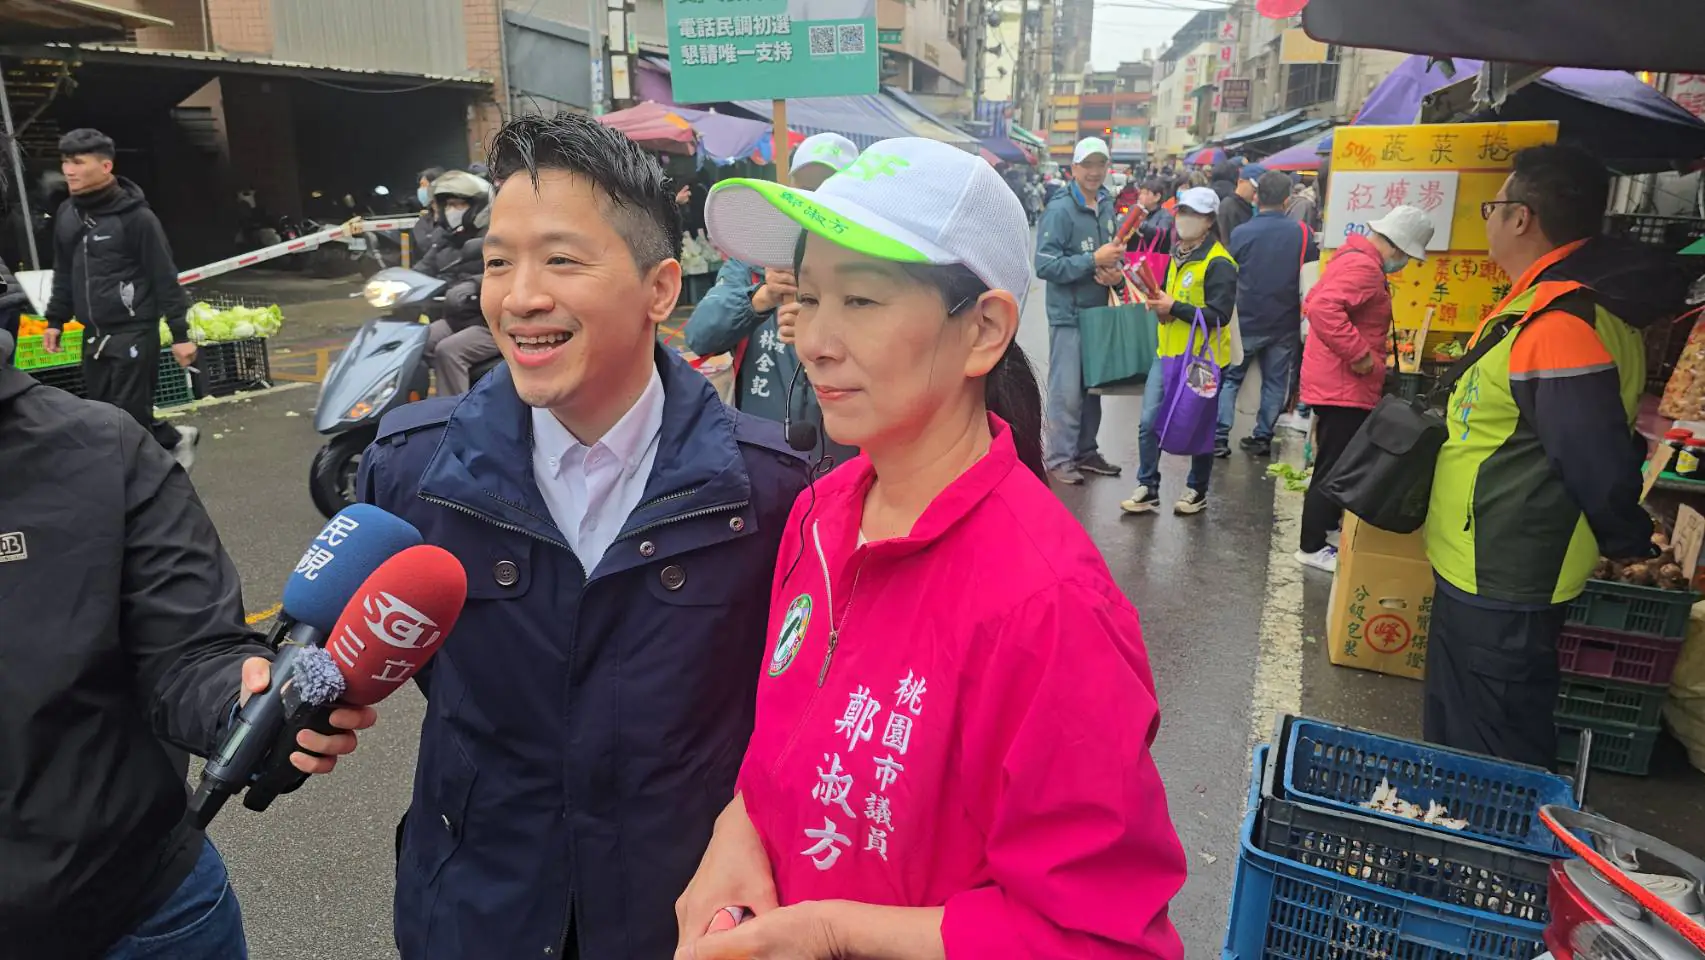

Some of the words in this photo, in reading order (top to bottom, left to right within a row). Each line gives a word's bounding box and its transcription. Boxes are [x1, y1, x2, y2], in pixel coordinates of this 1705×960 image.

[678, 14, 791, 39] 電話民調初選
[681, 41, 793, 65] 懇請唯一支持
[1381, 131, 1515, 165] 蔬菜捲
[1346, 177, 1445, 212] 紅燒湯
[751, 330, 775, 397] 林全記
[294, 515, 360, 581] 民視
[1344, 585, 1370, 657] 分級包裝
[333, 624, 416, 682] 三立
[800, 684, 881, 871] 鄭淑方
[863, 667, 927, 862] 桃園市議員
